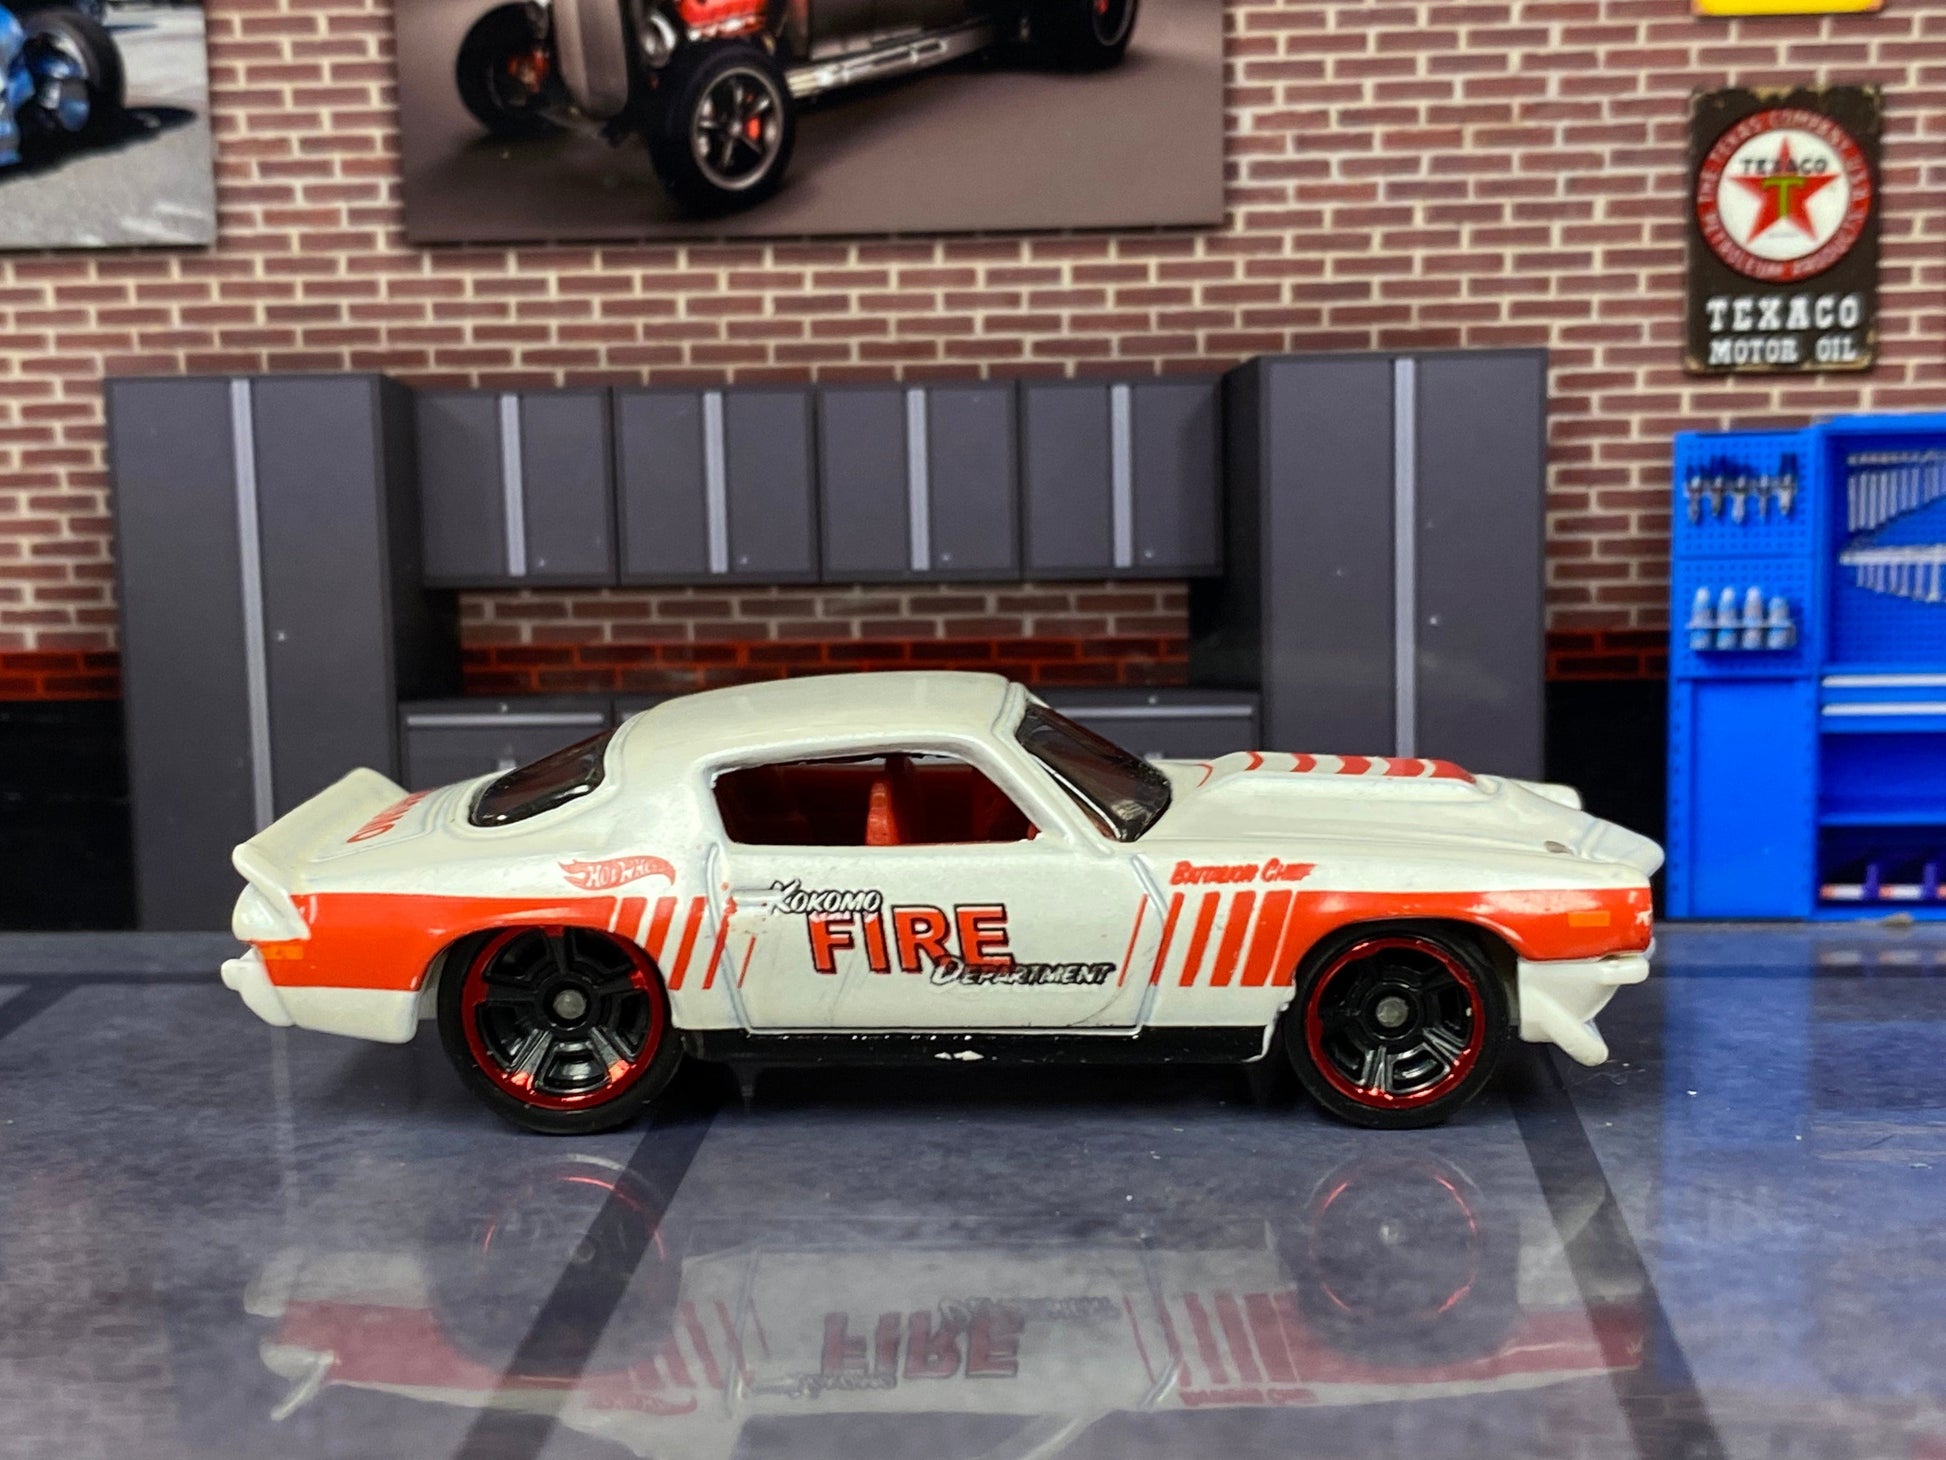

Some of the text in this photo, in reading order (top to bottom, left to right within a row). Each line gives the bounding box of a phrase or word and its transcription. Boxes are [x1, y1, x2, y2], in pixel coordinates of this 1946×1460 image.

[1706, 295, 1860, 332] TEXACO
[1708, 335, 1857, 365] MOTOR OIL
[766, 878, 884, 914] KOKOMO
[807, 904, 1015, 974] FIRE
[930, 954, 1116, 986] DEPARTMENT
